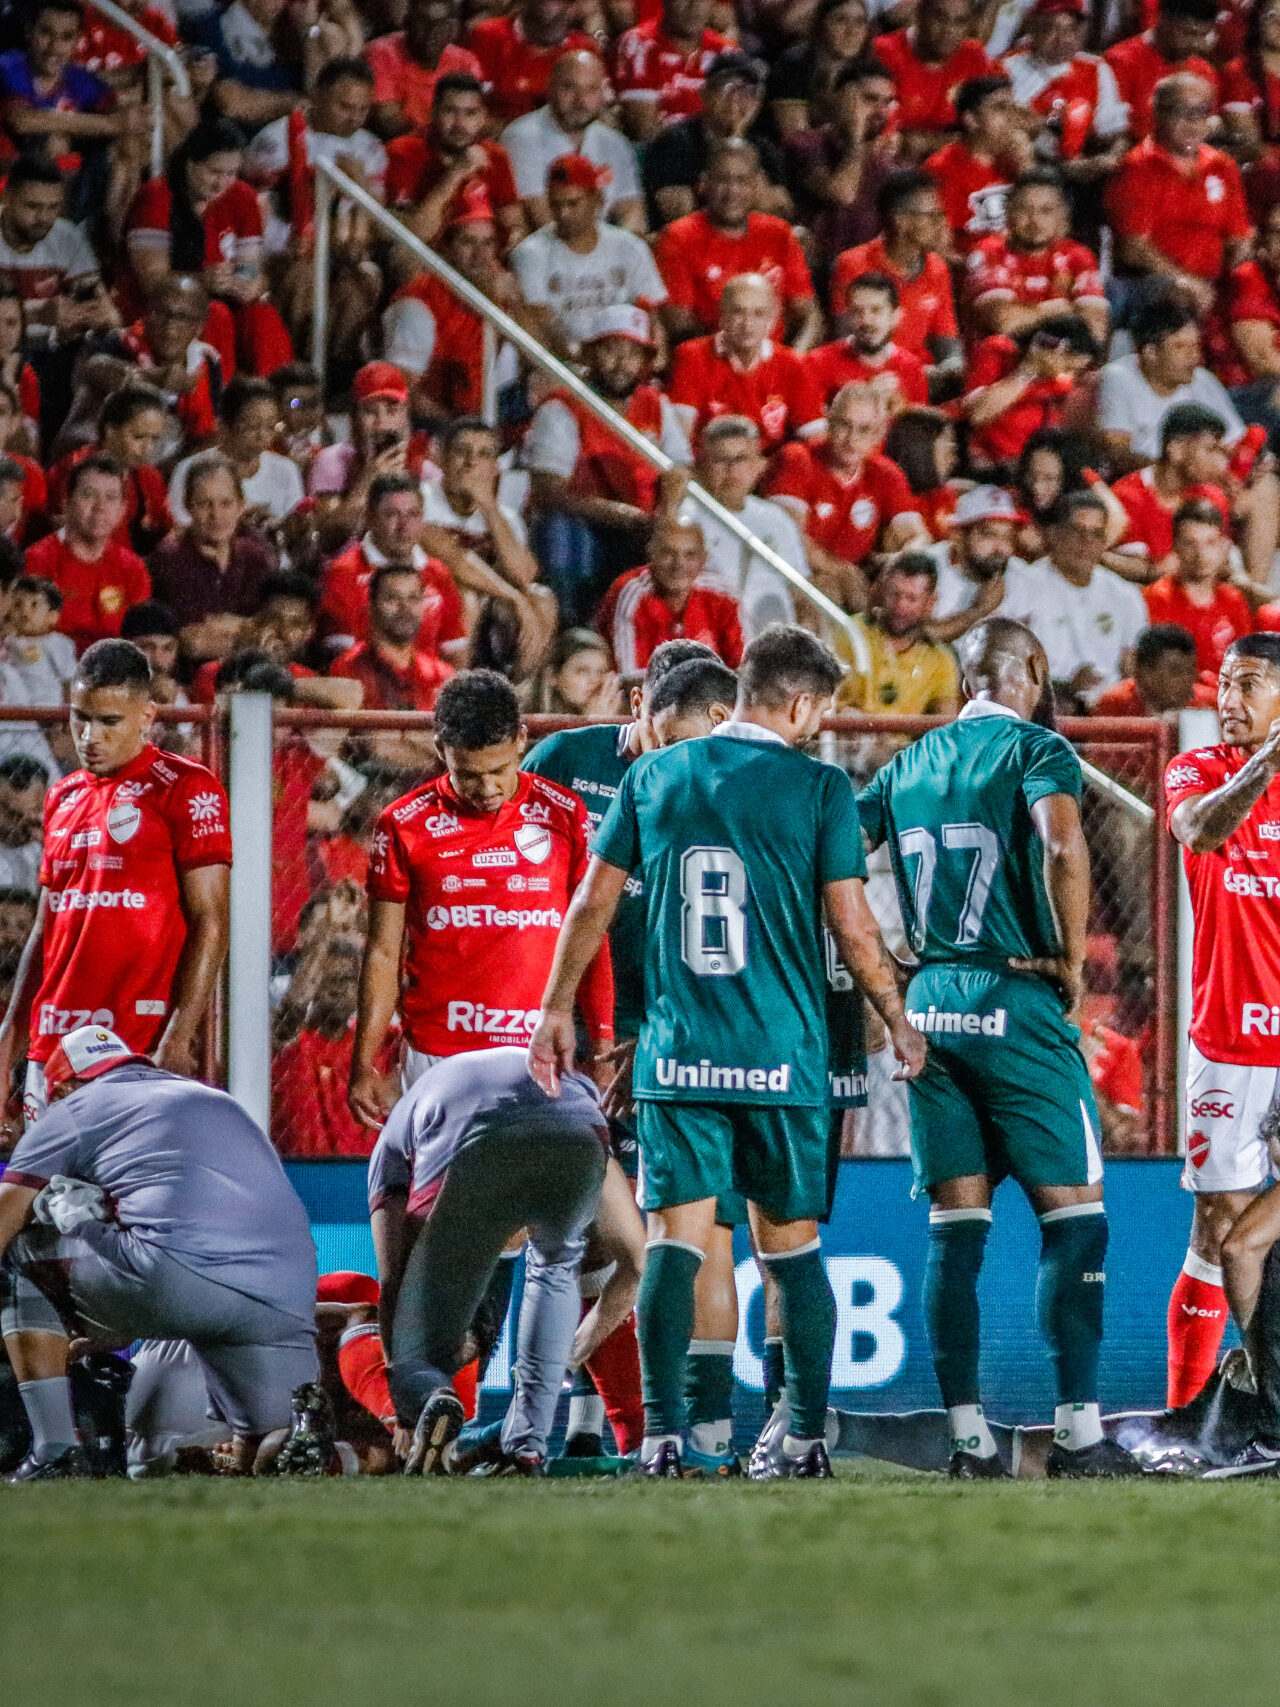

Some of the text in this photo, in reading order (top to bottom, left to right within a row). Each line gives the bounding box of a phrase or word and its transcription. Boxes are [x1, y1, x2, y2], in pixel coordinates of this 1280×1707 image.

[474, 854, 515, 865] LUZTOL
[898, 821, 1000, 953] 77
[450, 904, 562, 930] BETesporte
[680, 845, 747, 976] 8
[655, 1057, 791, 1092] Unimed
[1191, 1098, 1235, 1119] Sesc
